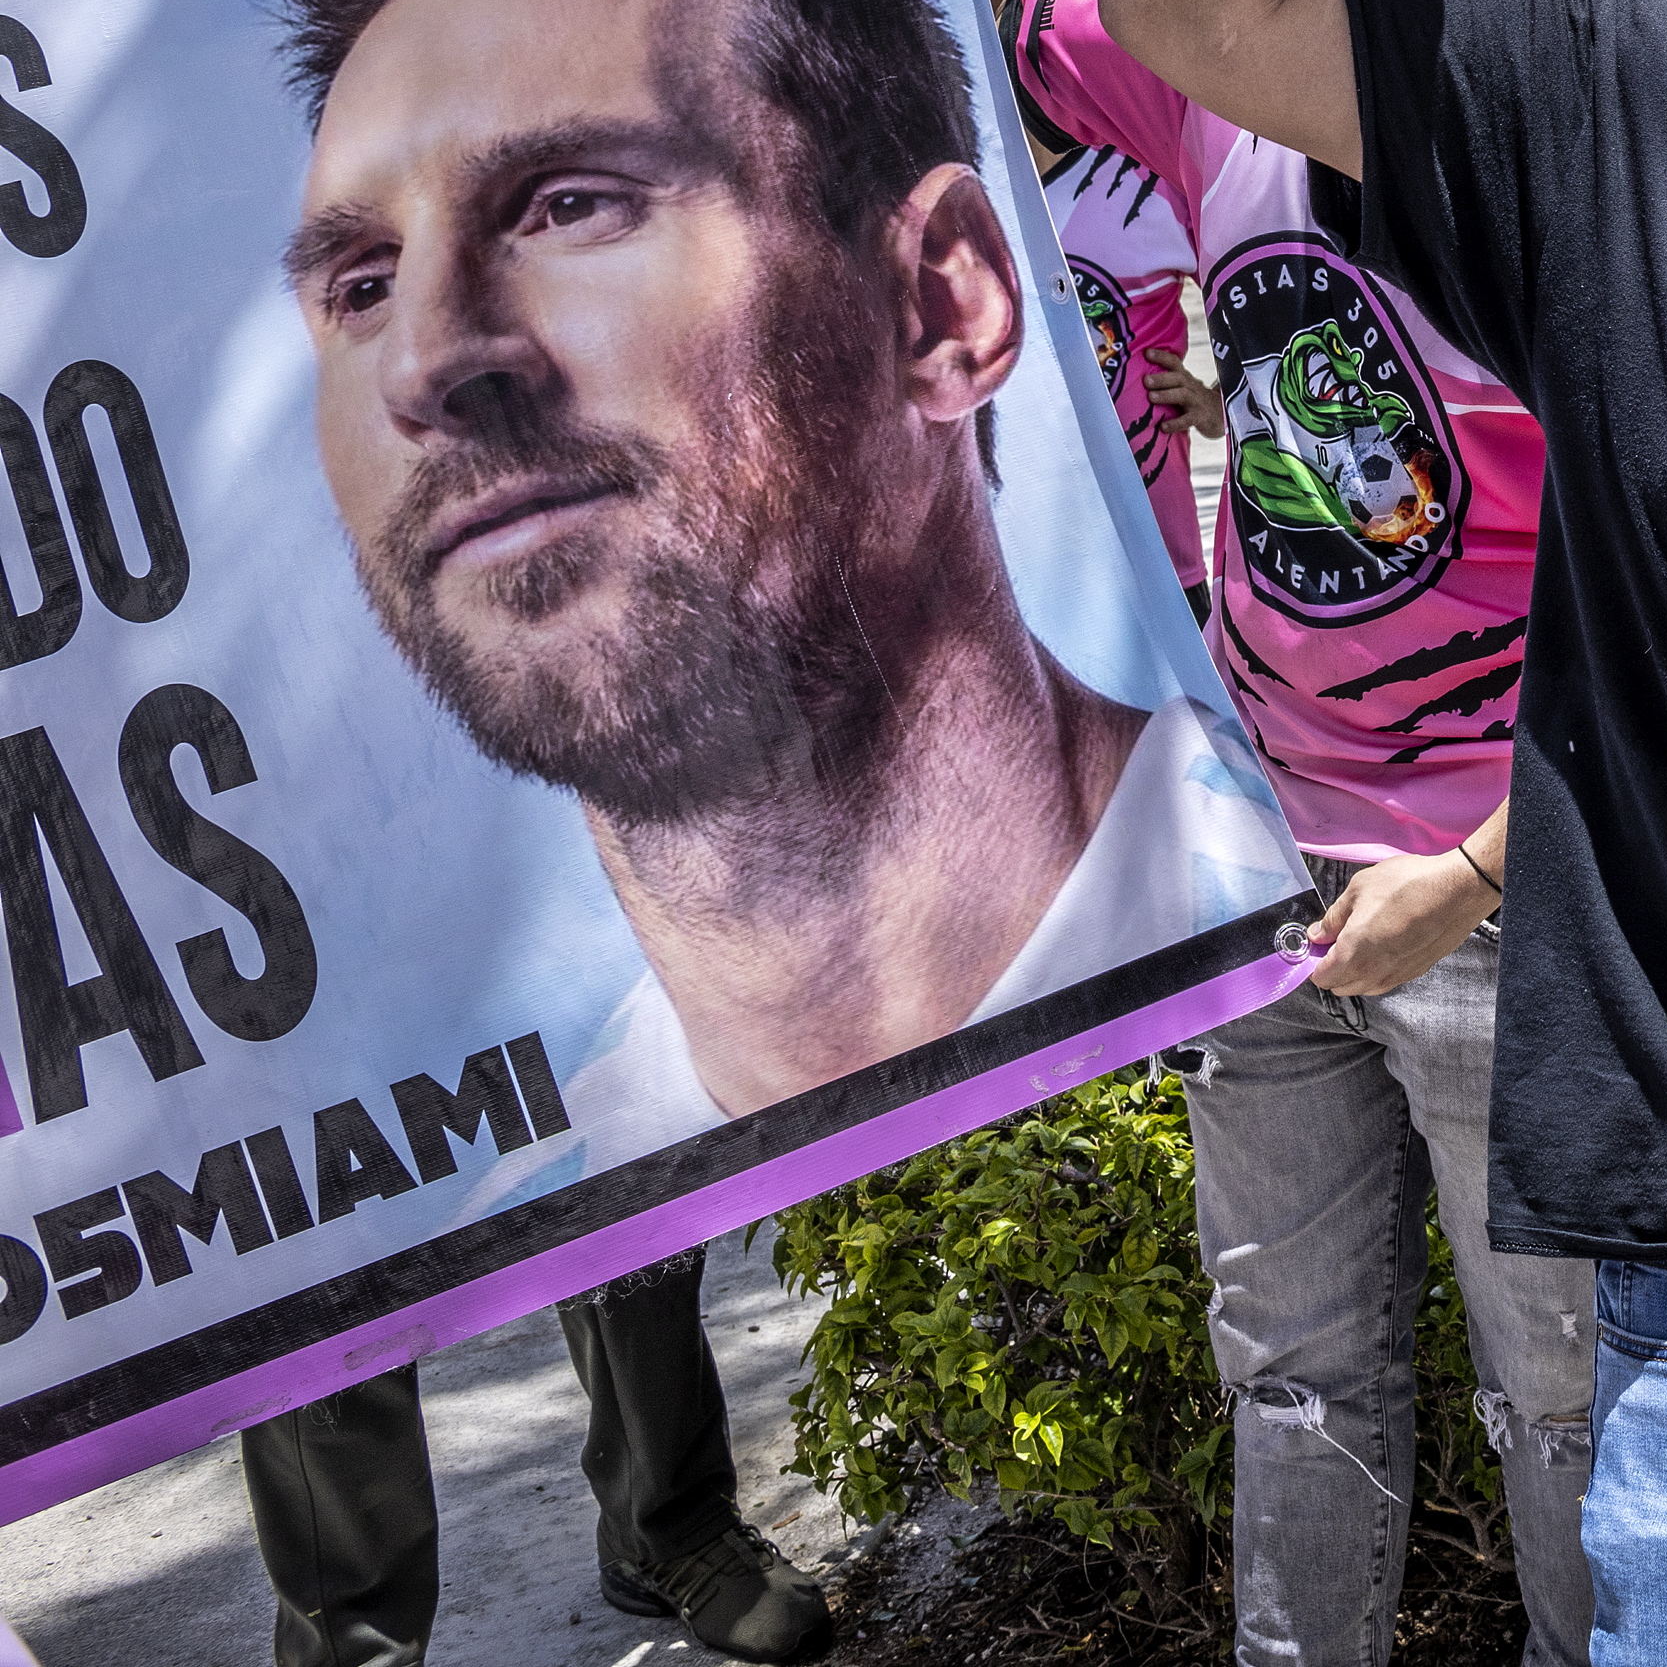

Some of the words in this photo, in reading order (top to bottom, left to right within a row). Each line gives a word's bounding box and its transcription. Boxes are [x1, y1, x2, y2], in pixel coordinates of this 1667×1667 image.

[1346, 297, 1399, 380] 305
[1314, 444, 1329, 469] 10
[1248, 501, 1447, 595] ALENTANDO
